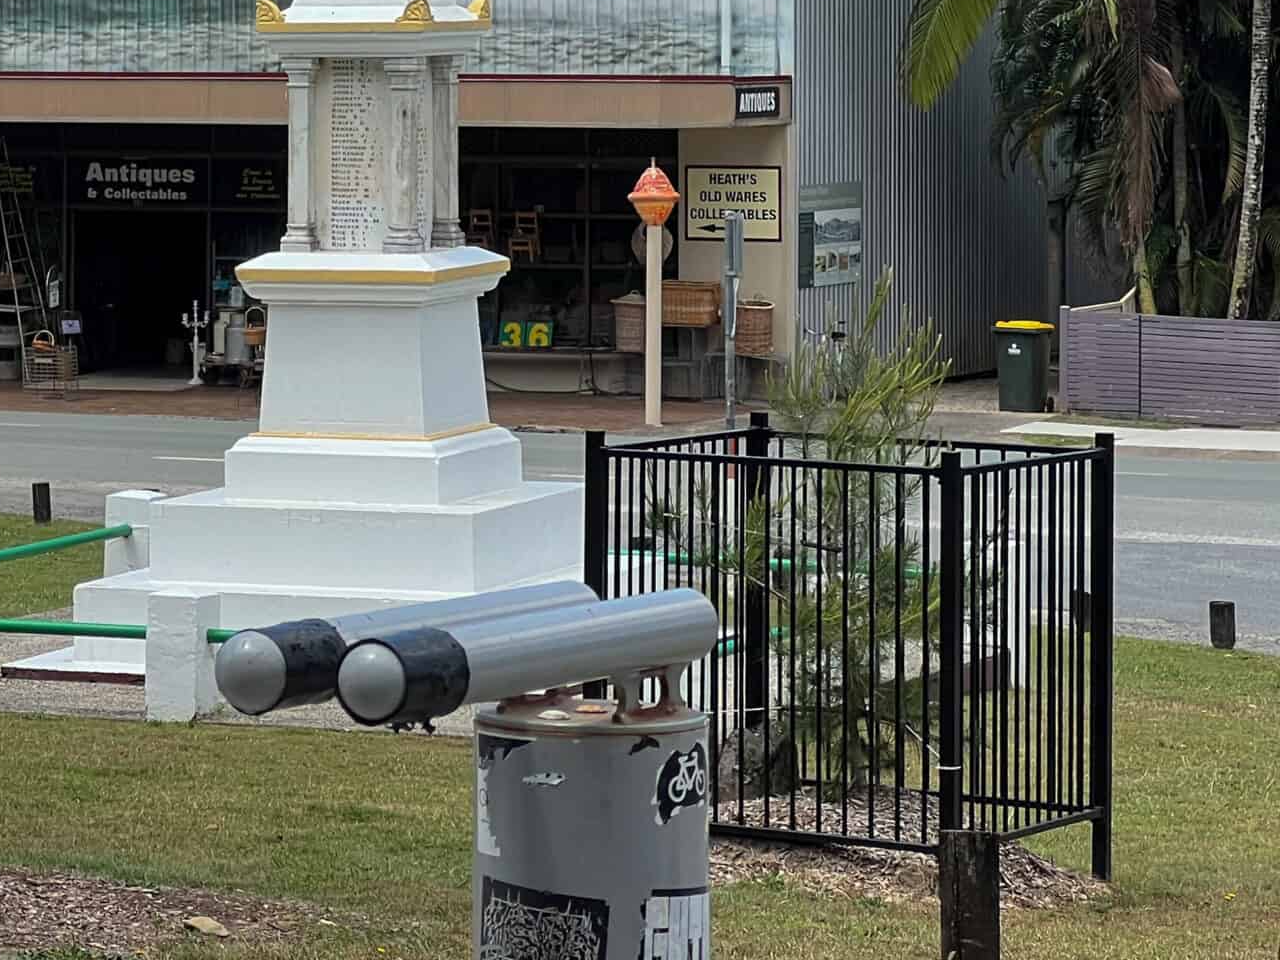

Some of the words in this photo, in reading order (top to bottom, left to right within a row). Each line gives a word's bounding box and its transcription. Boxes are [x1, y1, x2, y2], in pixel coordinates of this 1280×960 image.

[739, 92, 776, 112] ANTIQUES
[86, 162, 195, 186] Antiques
[709, 173, 757, 185] HEATH'S
[104, 187, 187, 200] Collectables
[700, 191, 721, 202] OLD
[726, 191, 767, 203] WARES
[690, 207, 777, 220] COLLEABLES
